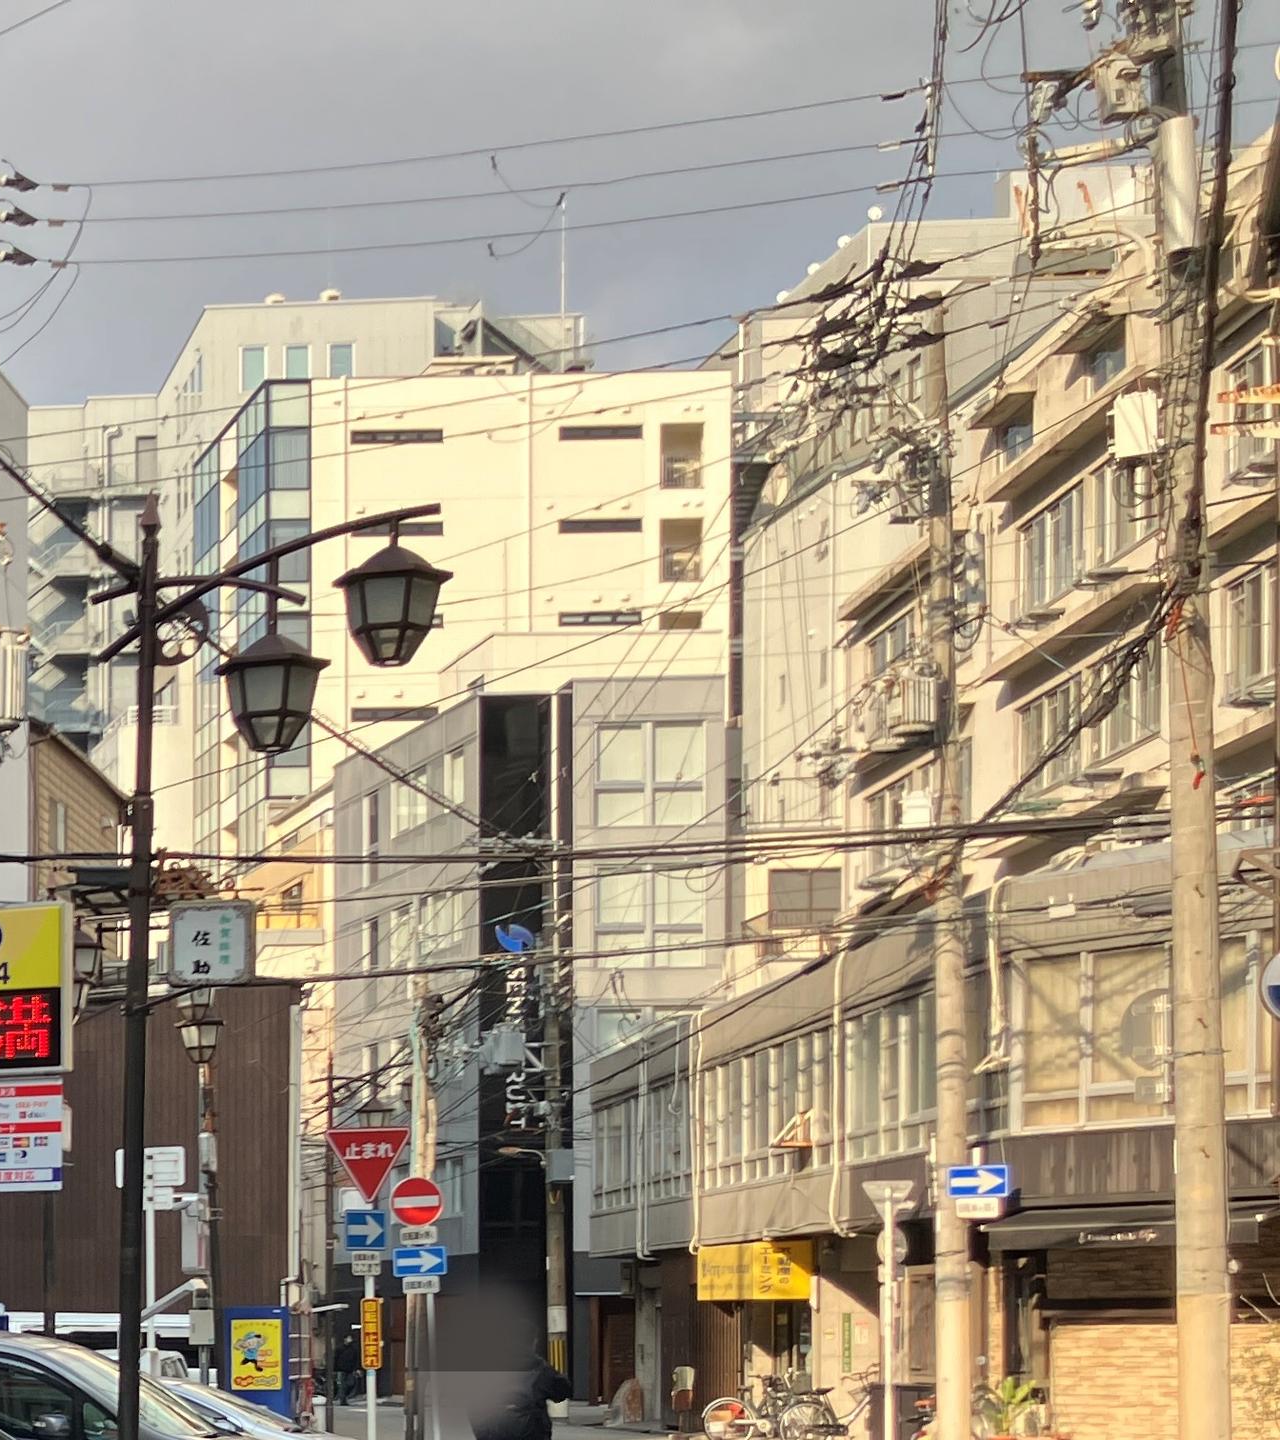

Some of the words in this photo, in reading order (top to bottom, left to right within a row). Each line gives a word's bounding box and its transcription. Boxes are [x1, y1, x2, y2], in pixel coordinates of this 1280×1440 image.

[192, 931, 211, 975] 佐助
[344, 1142, 394, 1160] 止まれ
